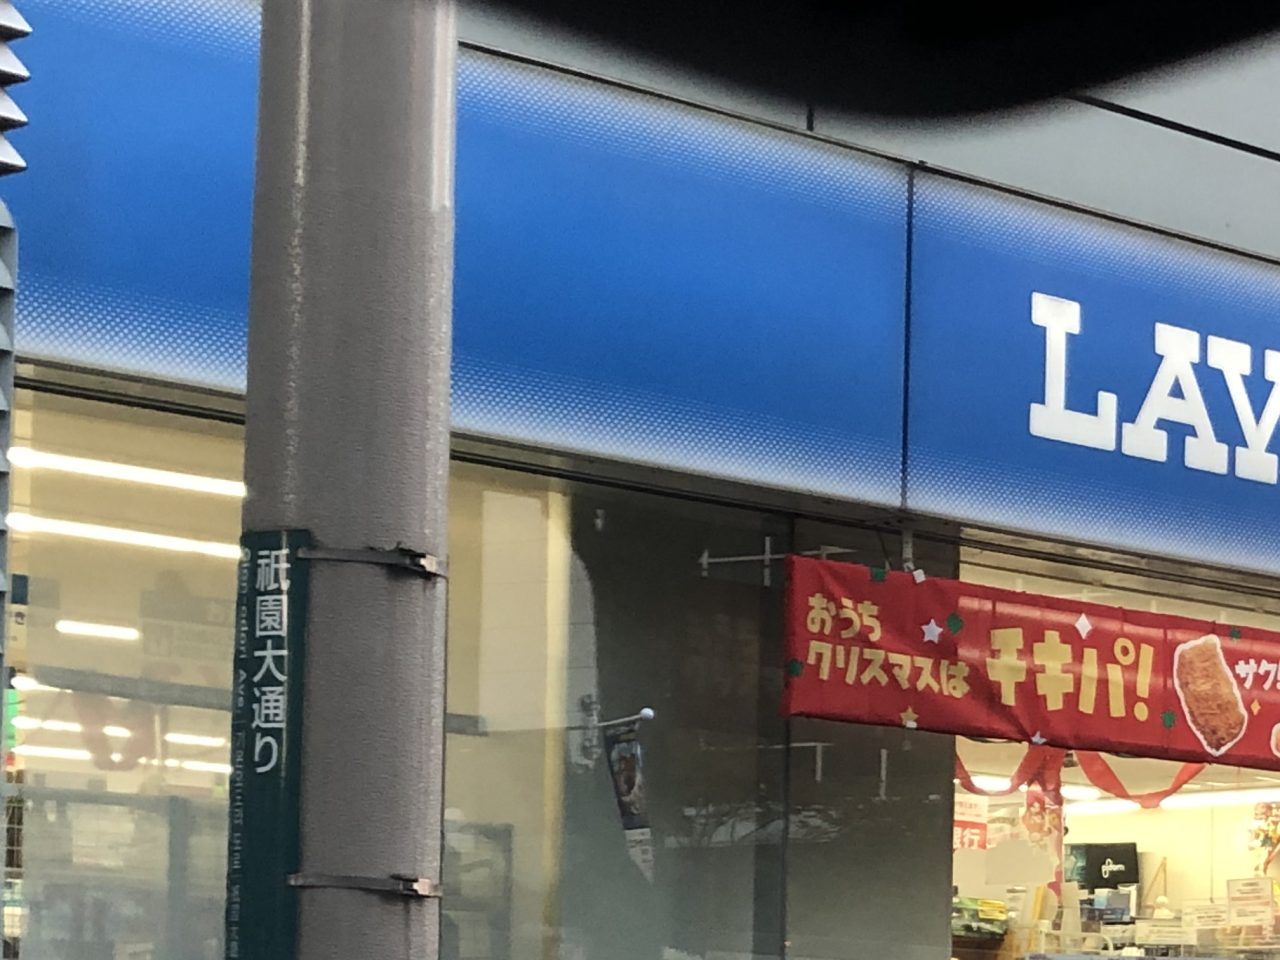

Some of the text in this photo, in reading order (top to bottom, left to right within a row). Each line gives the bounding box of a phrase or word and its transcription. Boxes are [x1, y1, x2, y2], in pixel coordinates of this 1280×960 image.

[806, 592, 881, 641] おうち
[252, 548, 291, 773] 祇園大通り
[805, 641, 972, 698] クリスマスは
